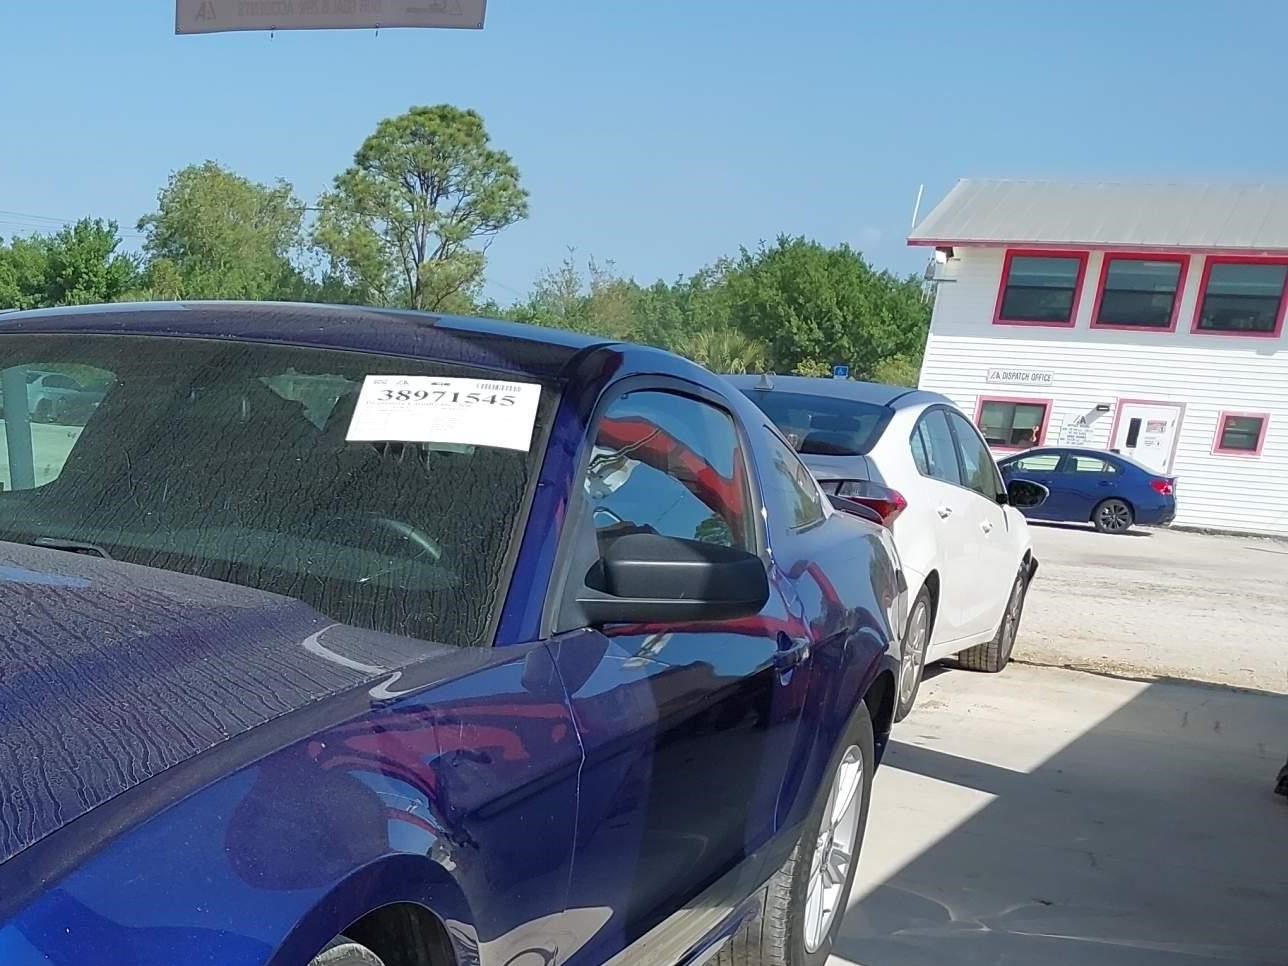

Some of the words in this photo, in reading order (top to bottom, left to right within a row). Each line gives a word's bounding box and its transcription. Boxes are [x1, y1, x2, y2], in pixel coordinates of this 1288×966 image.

[1002, 371, 1030, 381] DISPATCH
[1030, 373, 1052, 382] OFFICE
[377, 389, 516, 407] 38971545
